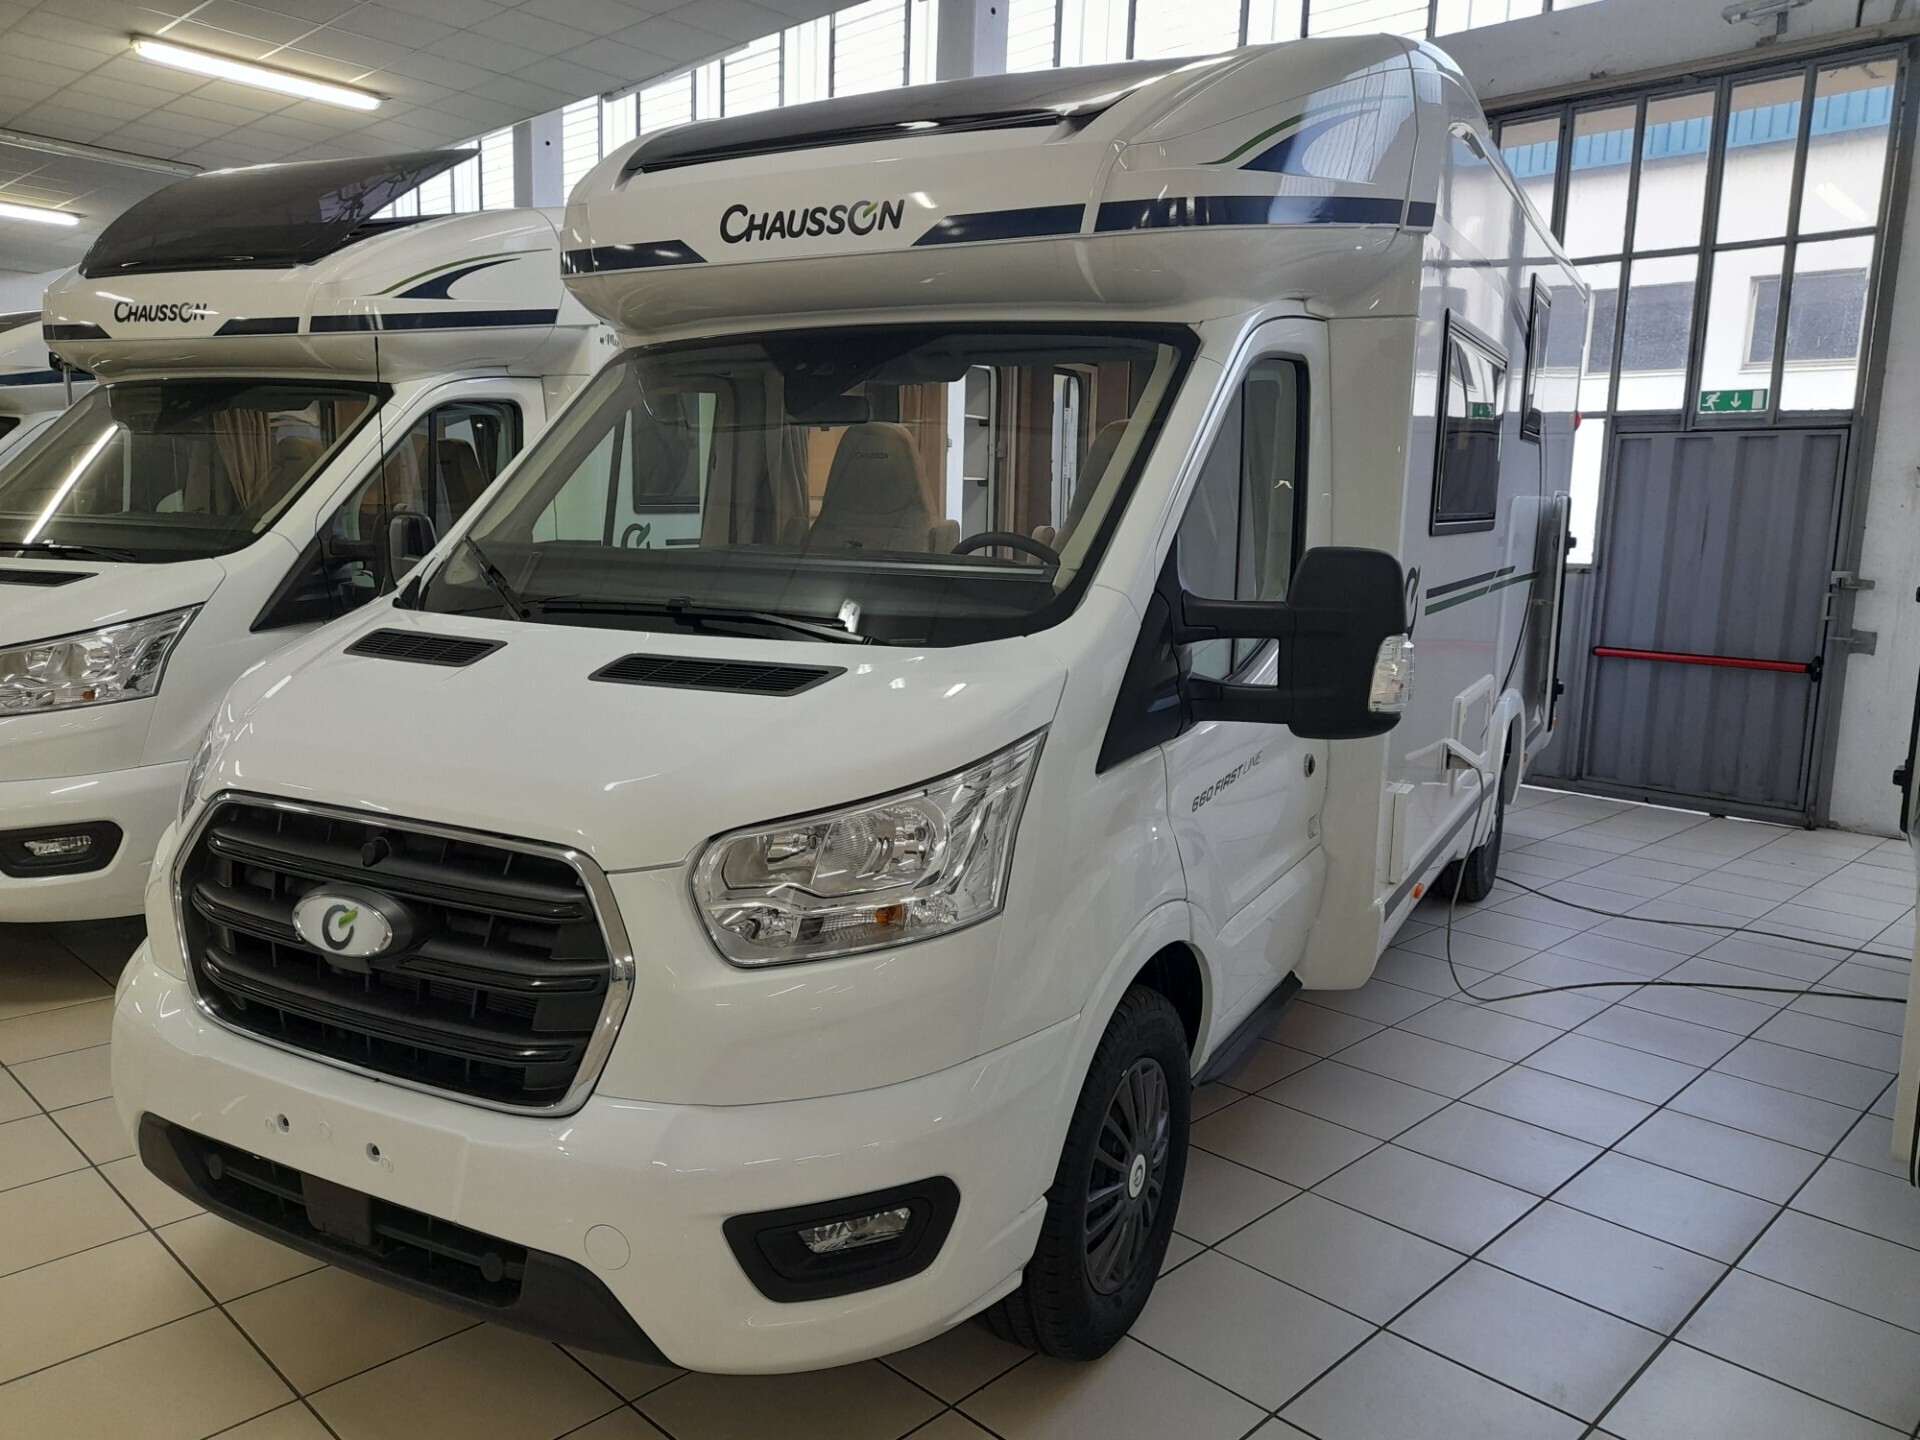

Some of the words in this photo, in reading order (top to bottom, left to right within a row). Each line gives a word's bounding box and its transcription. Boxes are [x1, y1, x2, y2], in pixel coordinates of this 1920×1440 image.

[720, 199, 905, 244] CHAUSSON
[114, 301, 207, 323] CHAUSSON
[1191, 785, 1214, 813] 660
